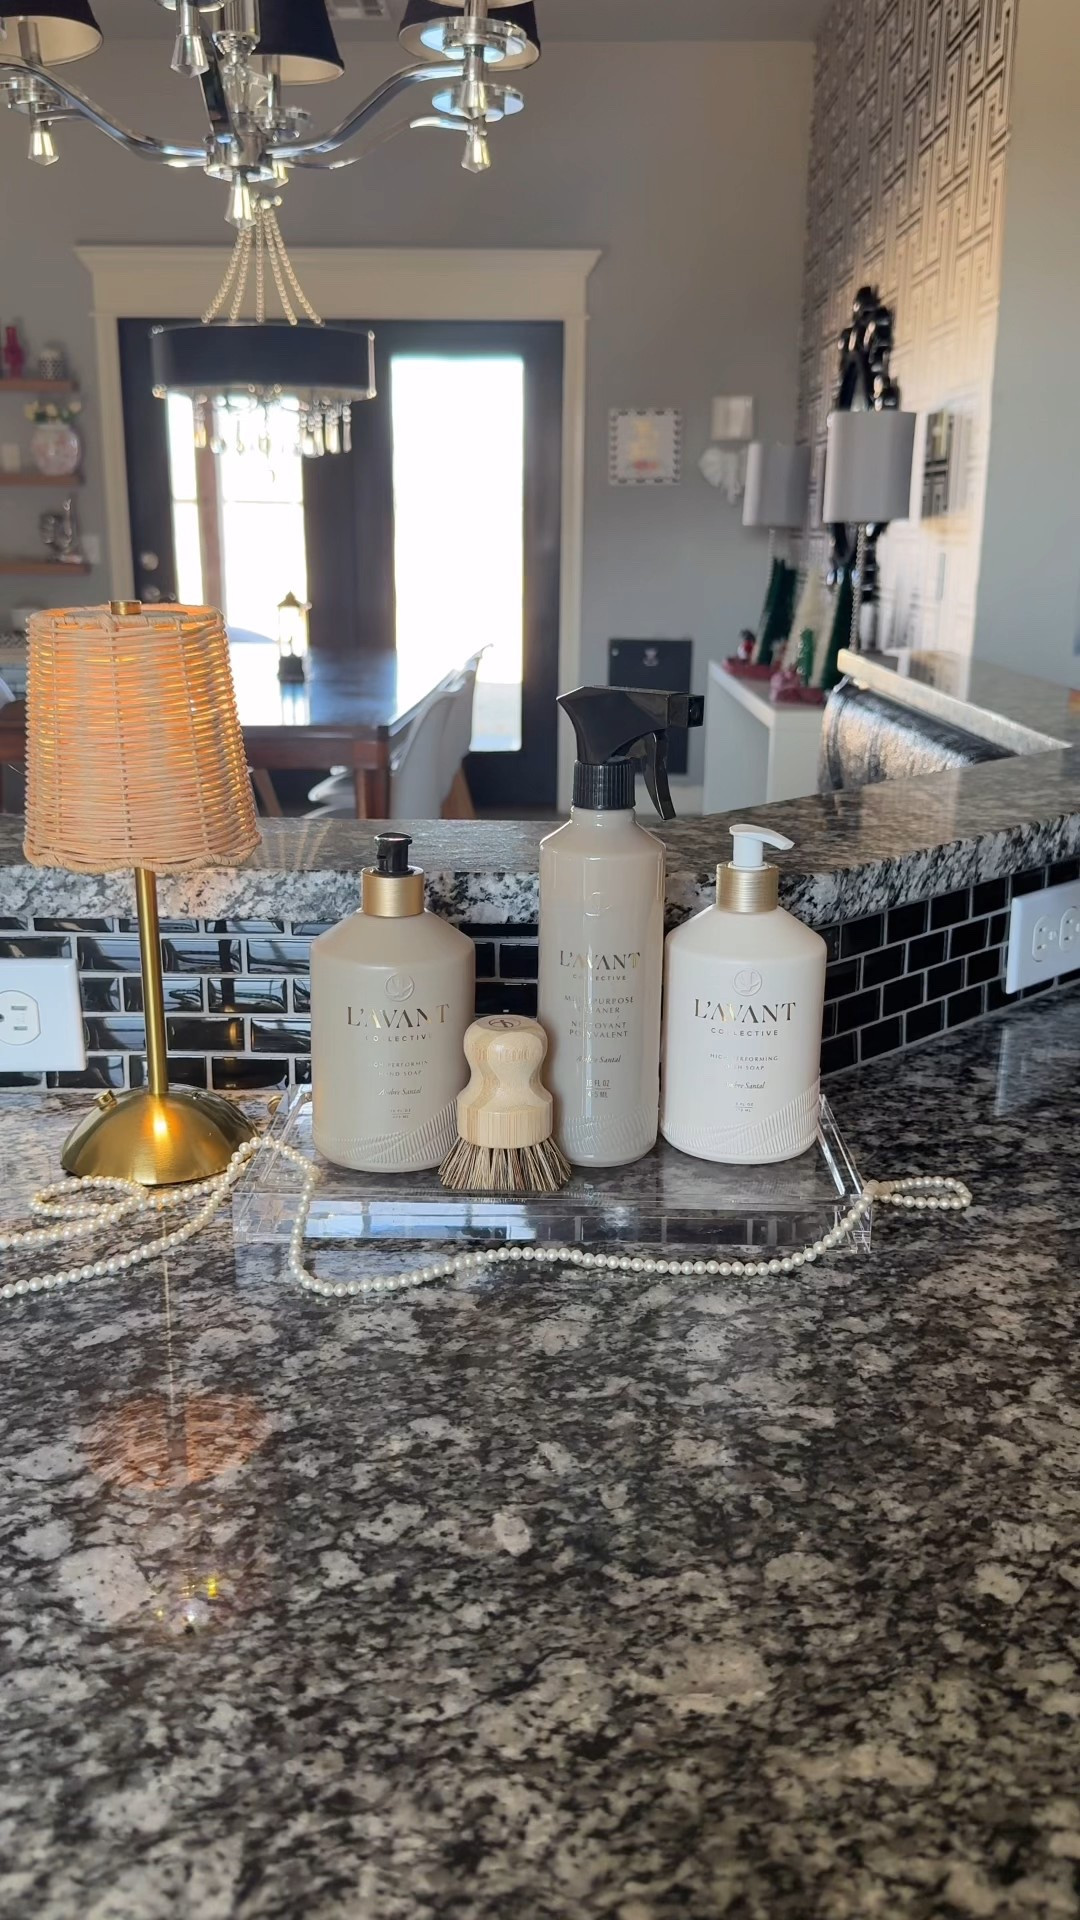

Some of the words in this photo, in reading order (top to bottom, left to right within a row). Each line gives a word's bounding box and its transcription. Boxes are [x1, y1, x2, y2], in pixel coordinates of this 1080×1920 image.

[347, 1004, 450, 1028] L'AVANT
[694, 998, 796, 1023] L'AVANT
[710, 1027, 779, 1037] COLECTIVE
